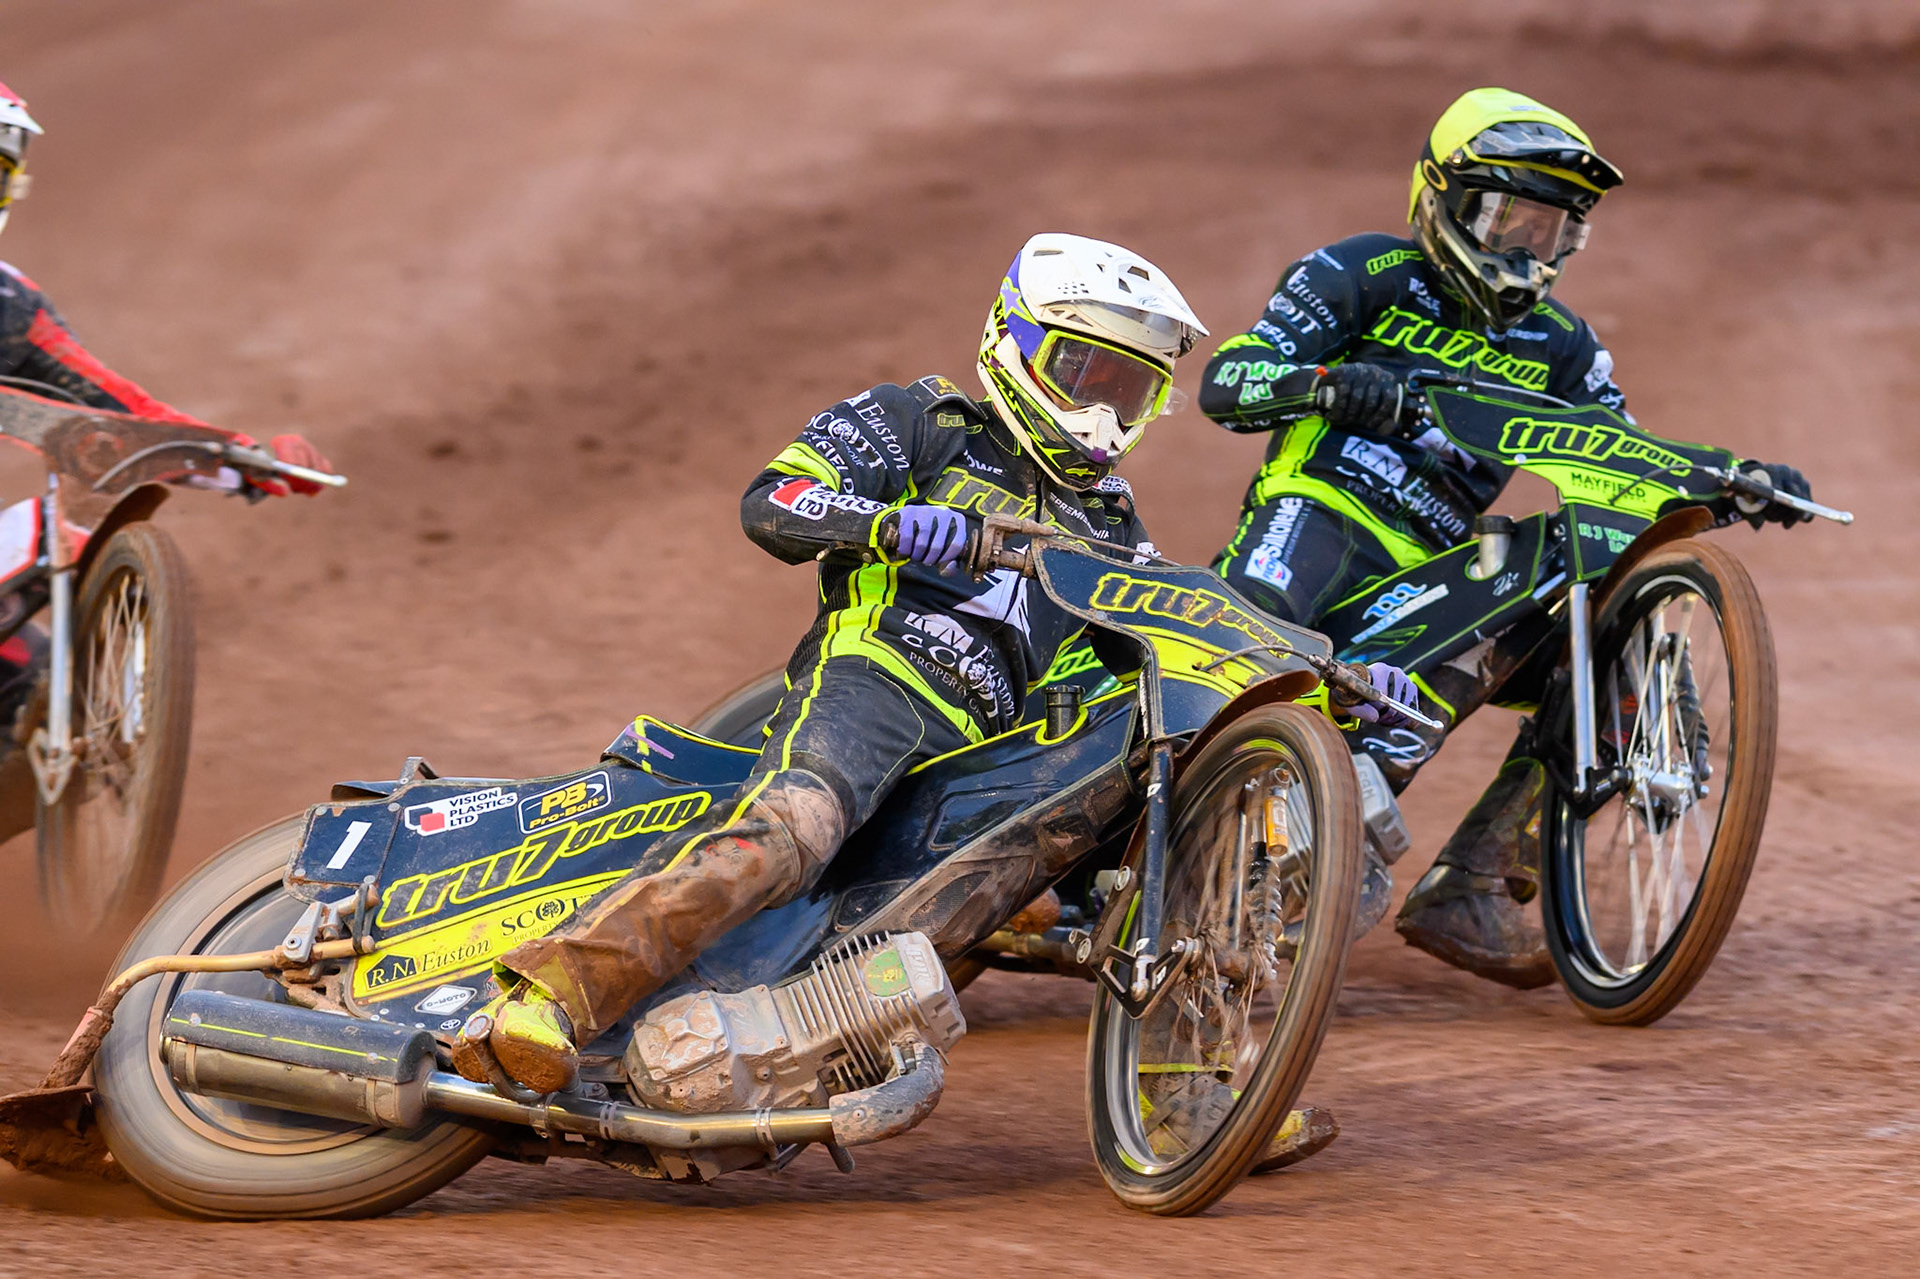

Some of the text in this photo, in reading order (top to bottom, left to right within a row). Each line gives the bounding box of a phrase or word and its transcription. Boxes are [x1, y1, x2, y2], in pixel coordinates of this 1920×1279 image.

[855, 402, 910, 471] Euston
[1570, 472, 1646, 498] MAYFIELD
[795, 497, 821, 516] LTD
[909, 652, 969, 699] PROPERTY
[449, 790, 498, 807] VISION
[450, 795, 514, 817] PLASTICS
[540, 781, 588, 816] PB
[450, 815, 474, 828] LTD
[326, 820, 372, 869] 1
[376, 791, 712, 928] tru7group
[501, 894, 595, 937] SCOT
[370, 939, 491, 987] R.N. Euston
